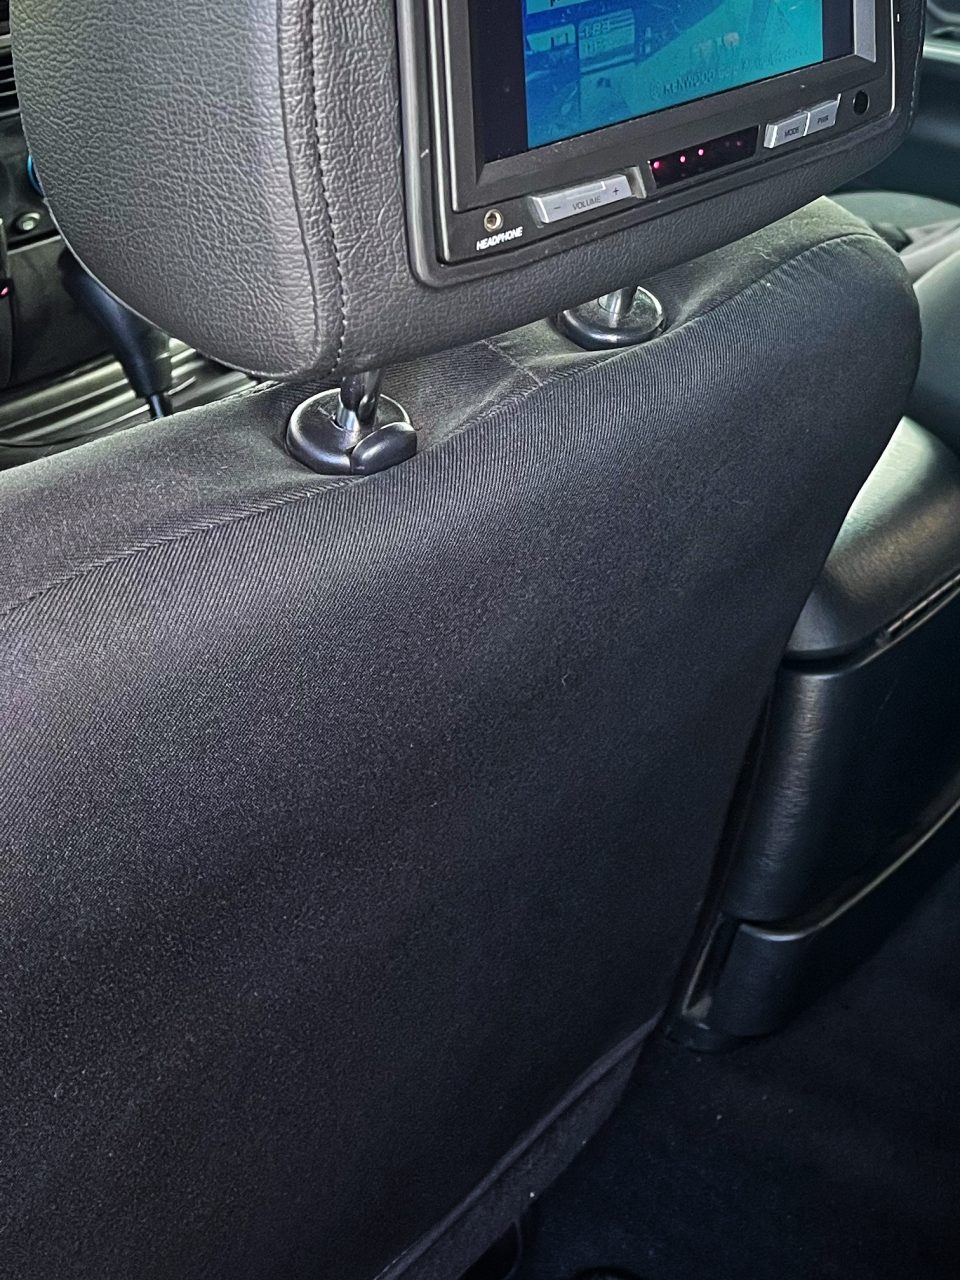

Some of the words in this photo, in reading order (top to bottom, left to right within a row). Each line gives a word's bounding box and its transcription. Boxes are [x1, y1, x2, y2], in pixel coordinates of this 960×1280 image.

[784, 127, 800, 138] MODE
[572, 197, 602, 212] VOLUME
[476, 226, 524, 251] HEADPHONE
